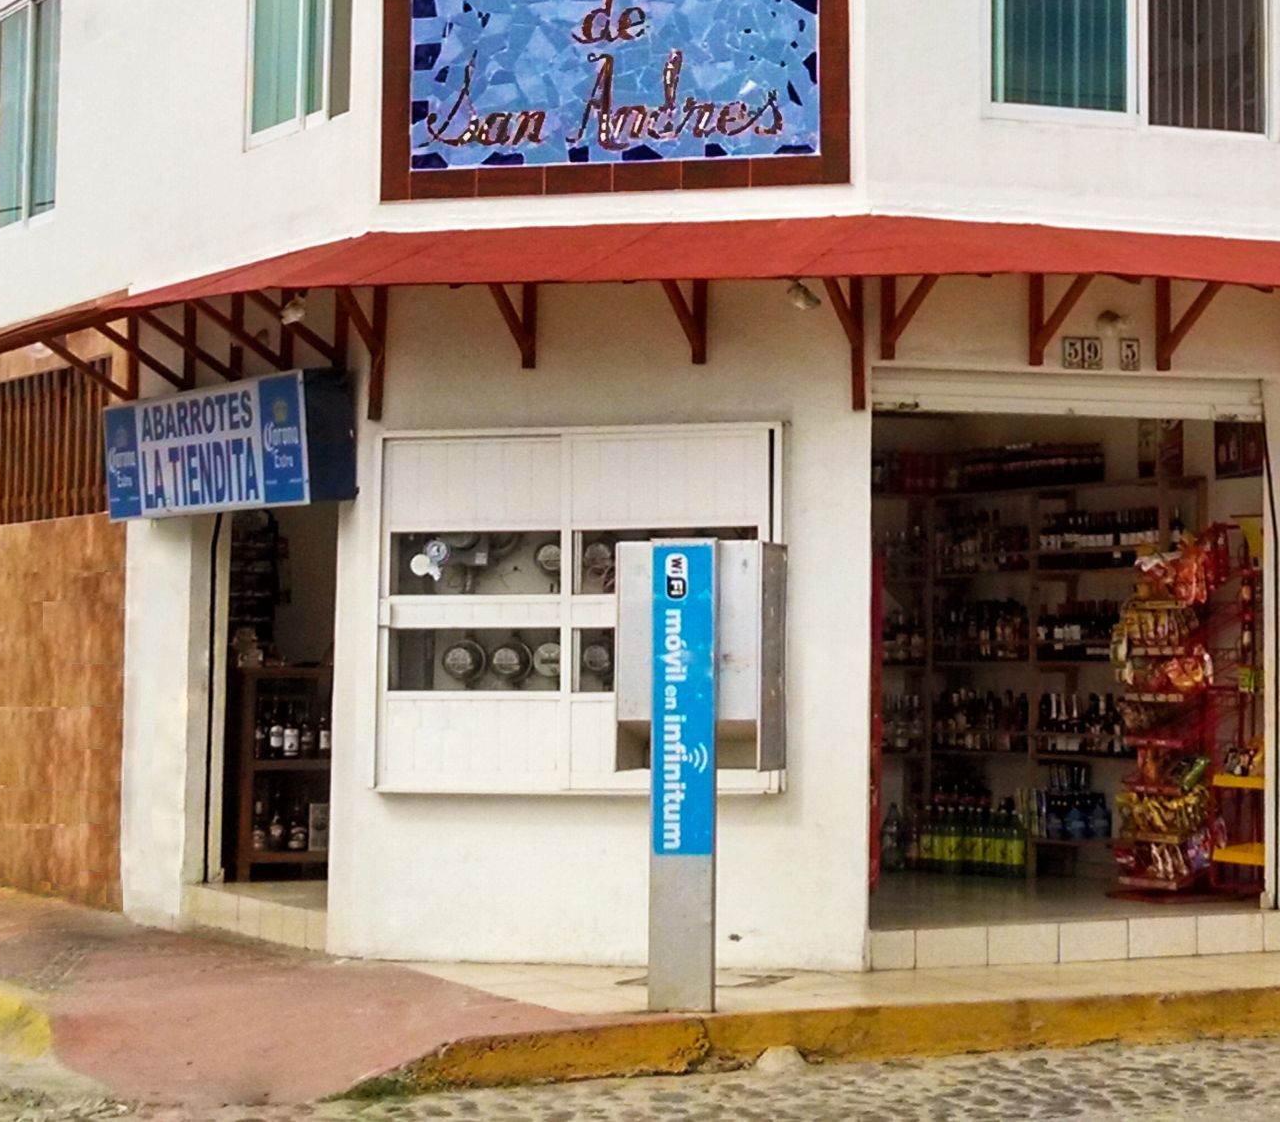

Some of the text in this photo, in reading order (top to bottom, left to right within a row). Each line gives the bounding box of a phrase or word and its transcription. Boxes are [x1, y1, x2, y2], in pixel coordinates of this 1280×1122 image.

[414, 47, 784, 151] San Andres
[142, 389, 254, 443] ABARROTES
[264, 421, 300, 454] Corona
[141, 437, 260, 510] LA TIENDITA
[664, 608, 688, 682] móvil
[664, 684, 678, 710] en
[663, 714, 688, 851] infinitum
